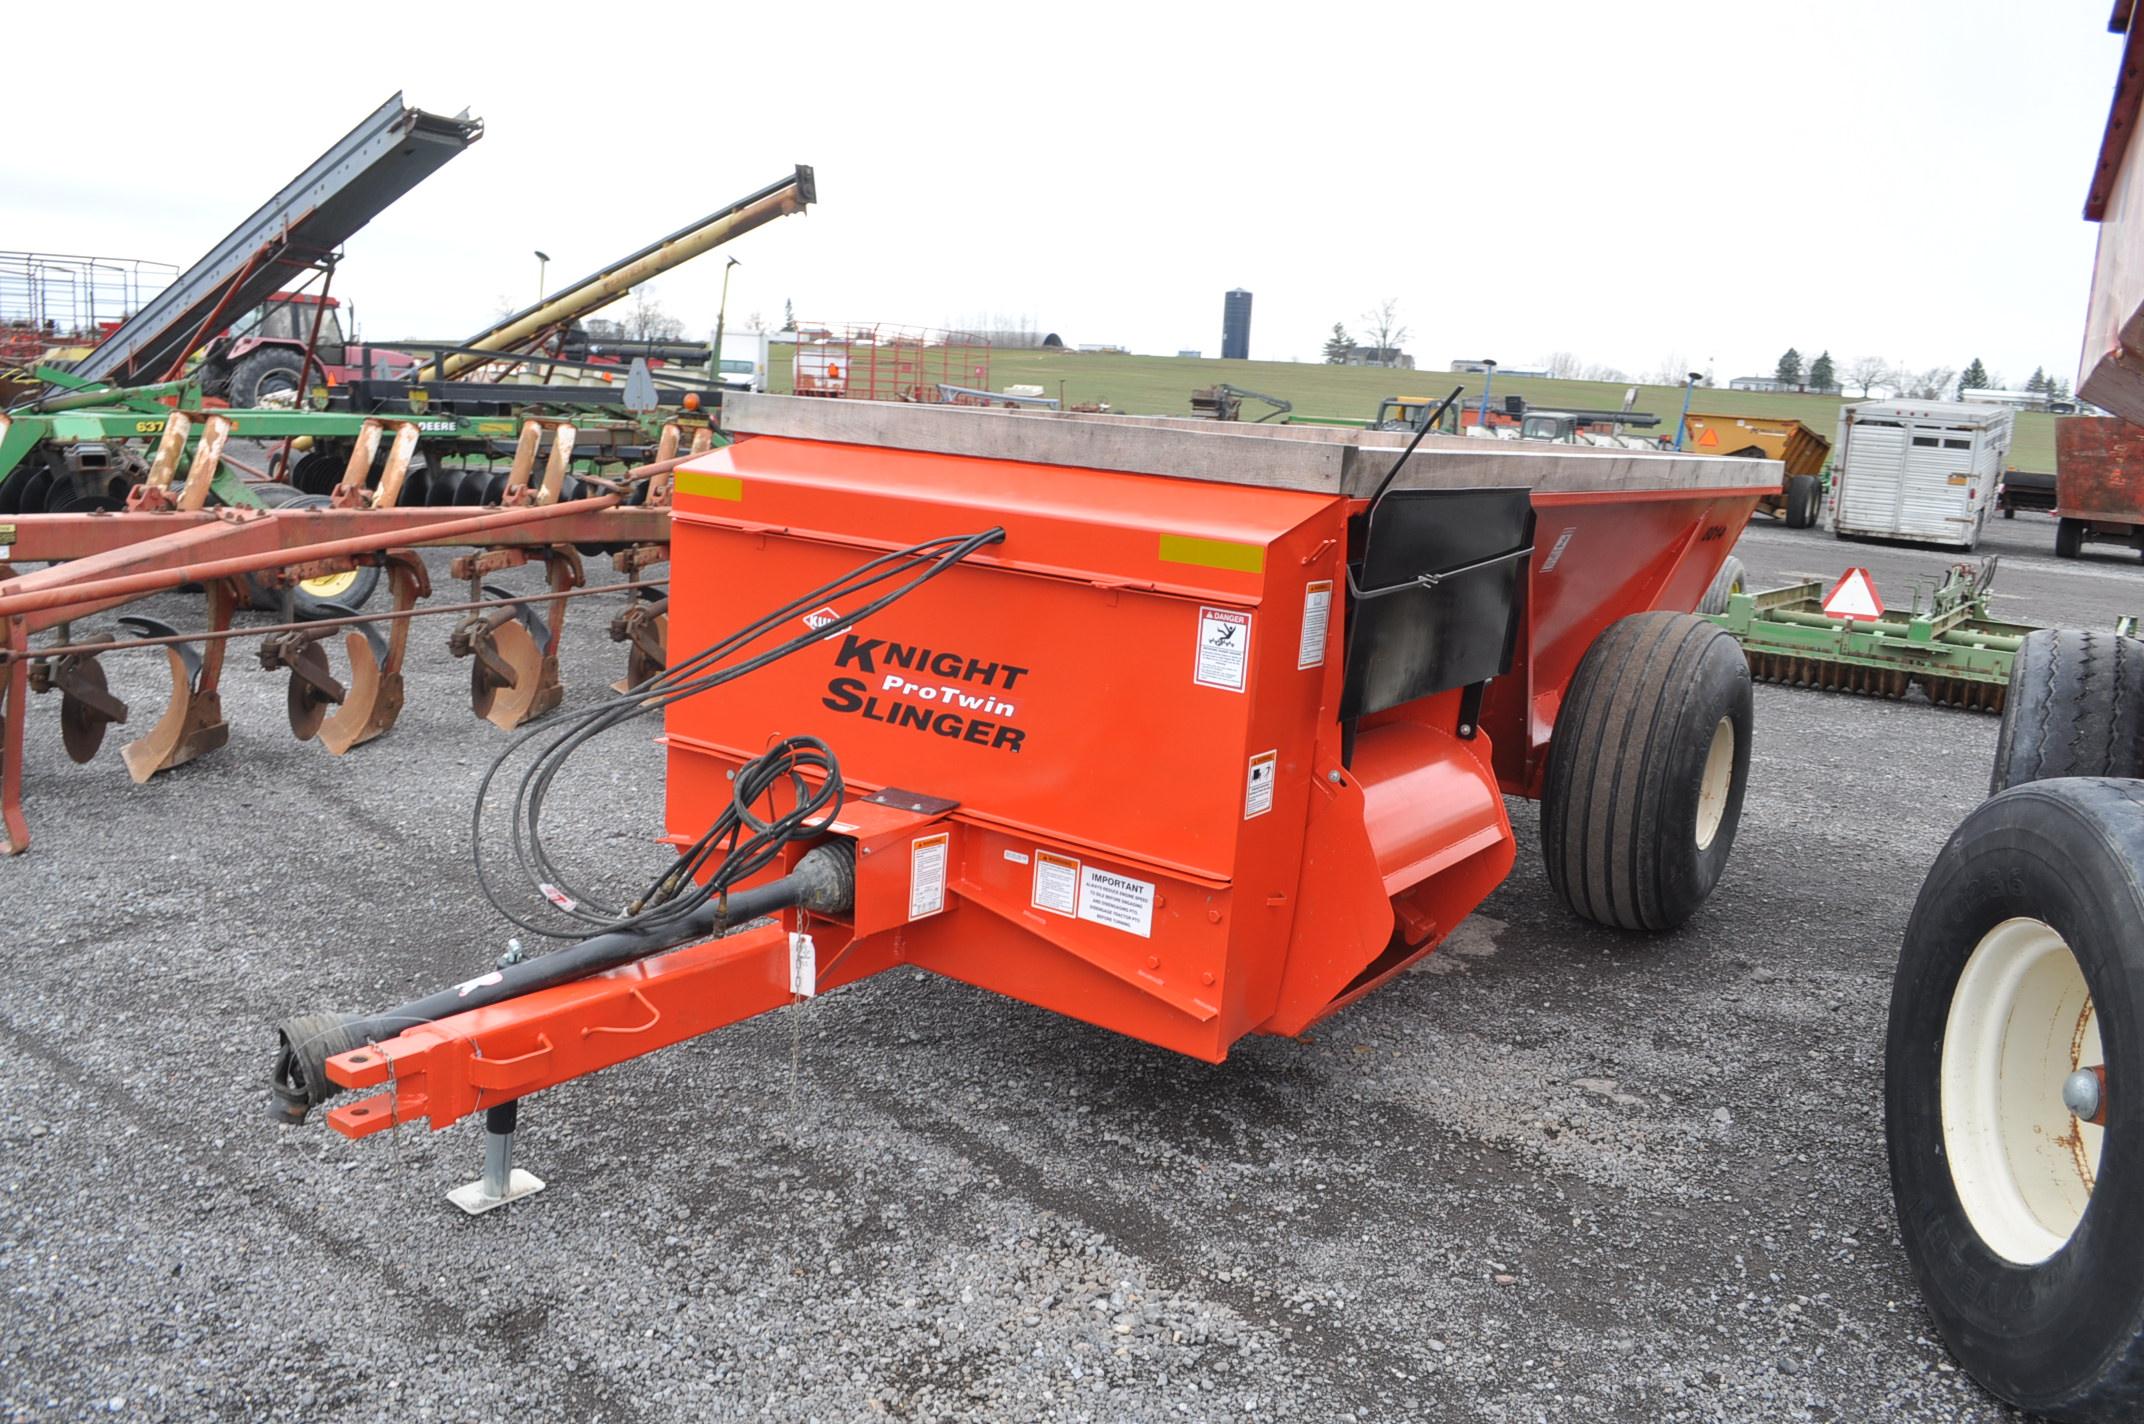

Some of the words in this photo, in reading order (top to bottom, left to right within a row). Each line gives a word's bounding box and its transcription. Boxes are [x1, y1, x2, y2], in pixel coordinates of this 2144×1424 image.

[136, 421, 165, 432] 637
[1214, 612, 1244, 623] DANGER
[834, 634, 1029, 690] KNIGHT
[882, 674, 1015, 717] ProTwin
[822, 677, 1026, 752] SLINGER
[1091, 872, 1144, 894] IMPORTANT
